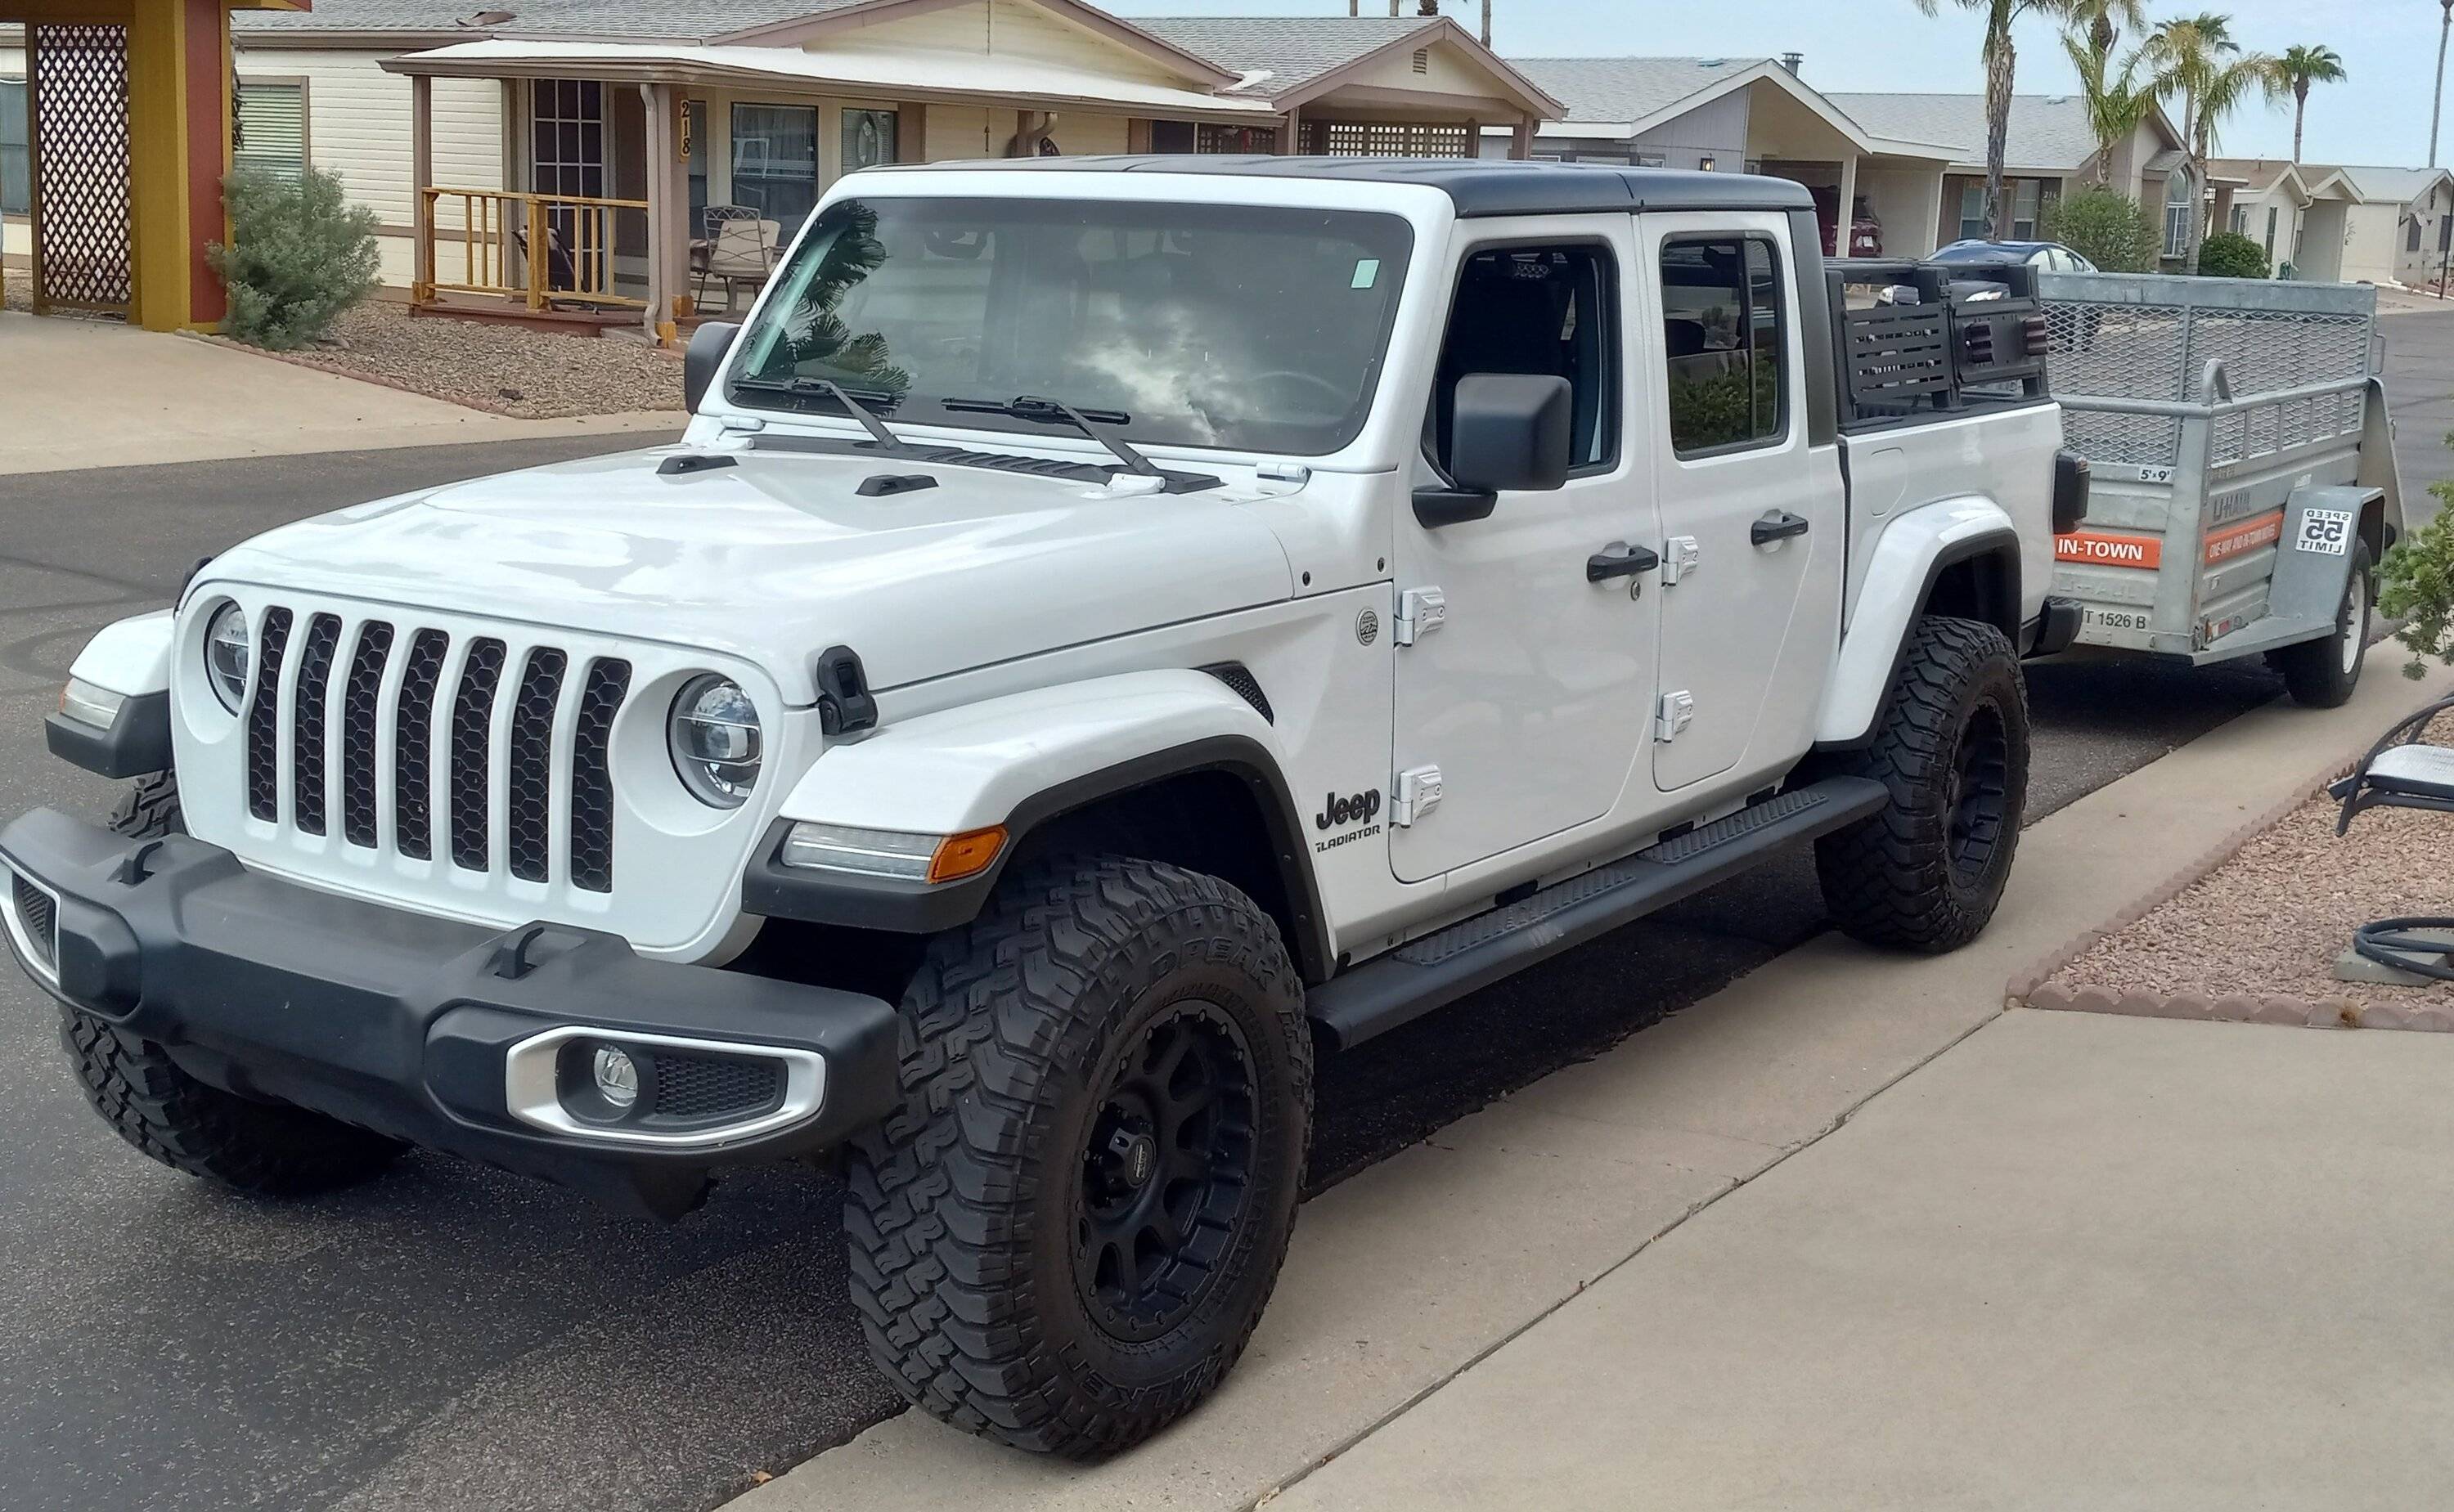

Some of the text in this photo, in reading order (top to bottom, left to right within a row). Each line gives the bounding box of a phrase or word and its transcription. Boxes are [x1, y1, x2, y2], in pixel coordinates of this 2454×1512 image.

[681, 101, 690, 155] 218
[2057, 538, 2144, 561] IN-TOWN
[2098, 612, 2132, 628] 1526
[2136, 615, 2146, 630] B
[1316, 788, 1381, 830] Jeep
